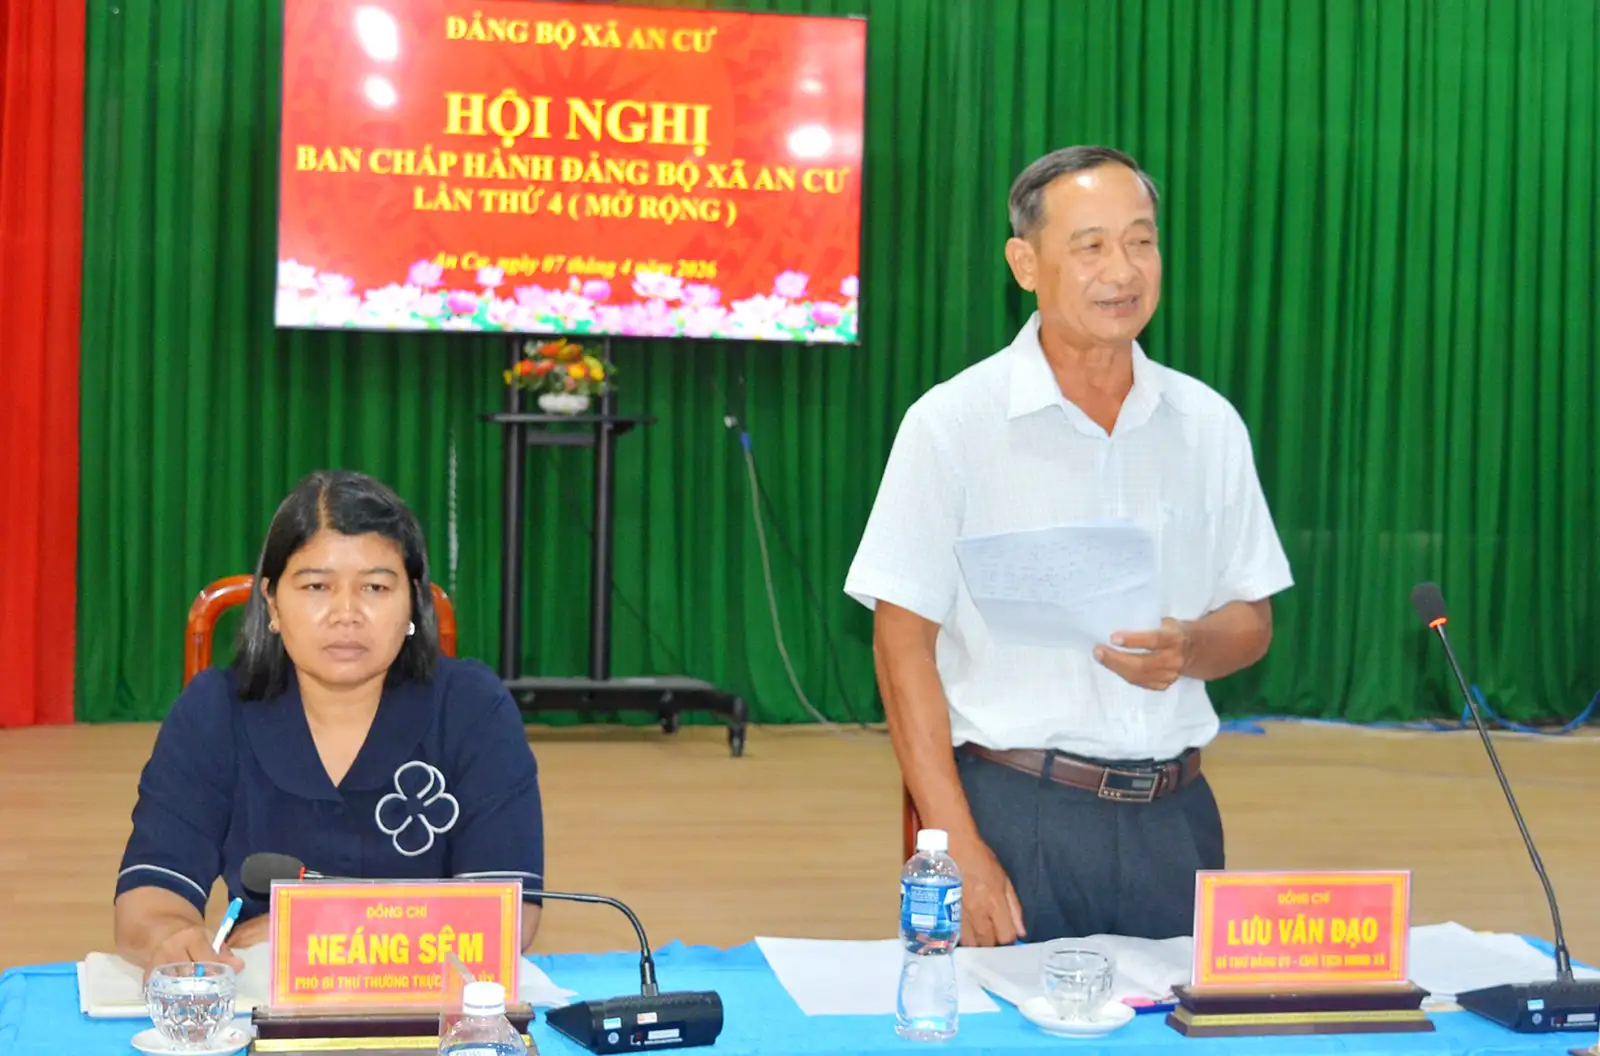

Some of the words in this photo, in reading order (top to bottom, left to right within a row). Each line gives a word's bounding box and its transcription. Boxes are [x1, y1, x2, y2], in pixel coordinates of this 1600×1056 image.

[446, 10, 528, 43] ĐẢNG
[535, 18, 576, 50] BỘ
[581, 20, 622, 48] XÃ
[627, 27, 666, 50] AN
[671, 27, 717, 52] CƯ
[443, 88, 552, 148] HỘI
[565, 97, 711, 157] NGHỊ
[296, 144, 363, 172] BAN
[368, 143, 457, 176] CHẤP
[463, 147, 554, 181] HÀNH
[561, 151, 649, 185] ĐẢNG
[656, 157, 700, 192] BỘ
[705, 159, 749, 189] XÃ
[754, 167, 796, 191] AN
[802, 166, 850, 193] CƯ
[478, 184, 545, 214] THỨ
[547, 192, 563, 215] 4
[585, 188, 634, 219] MỞ
[639, 193, 720, 225] RỘNG
[541, 255, 566, 273] 07
[308, 926, 409, 965] NEÁNG
[418, 924, 484, 964] SÊM
[1228, 914, 1272, 945] LƯU
[1278, 913, 1324, 944] VĂN
[1331, 917, 1378, 949] ĐẠO
[296, 973, 318, 989] PHÓ
[337, 974, 360, 989] THƯ
